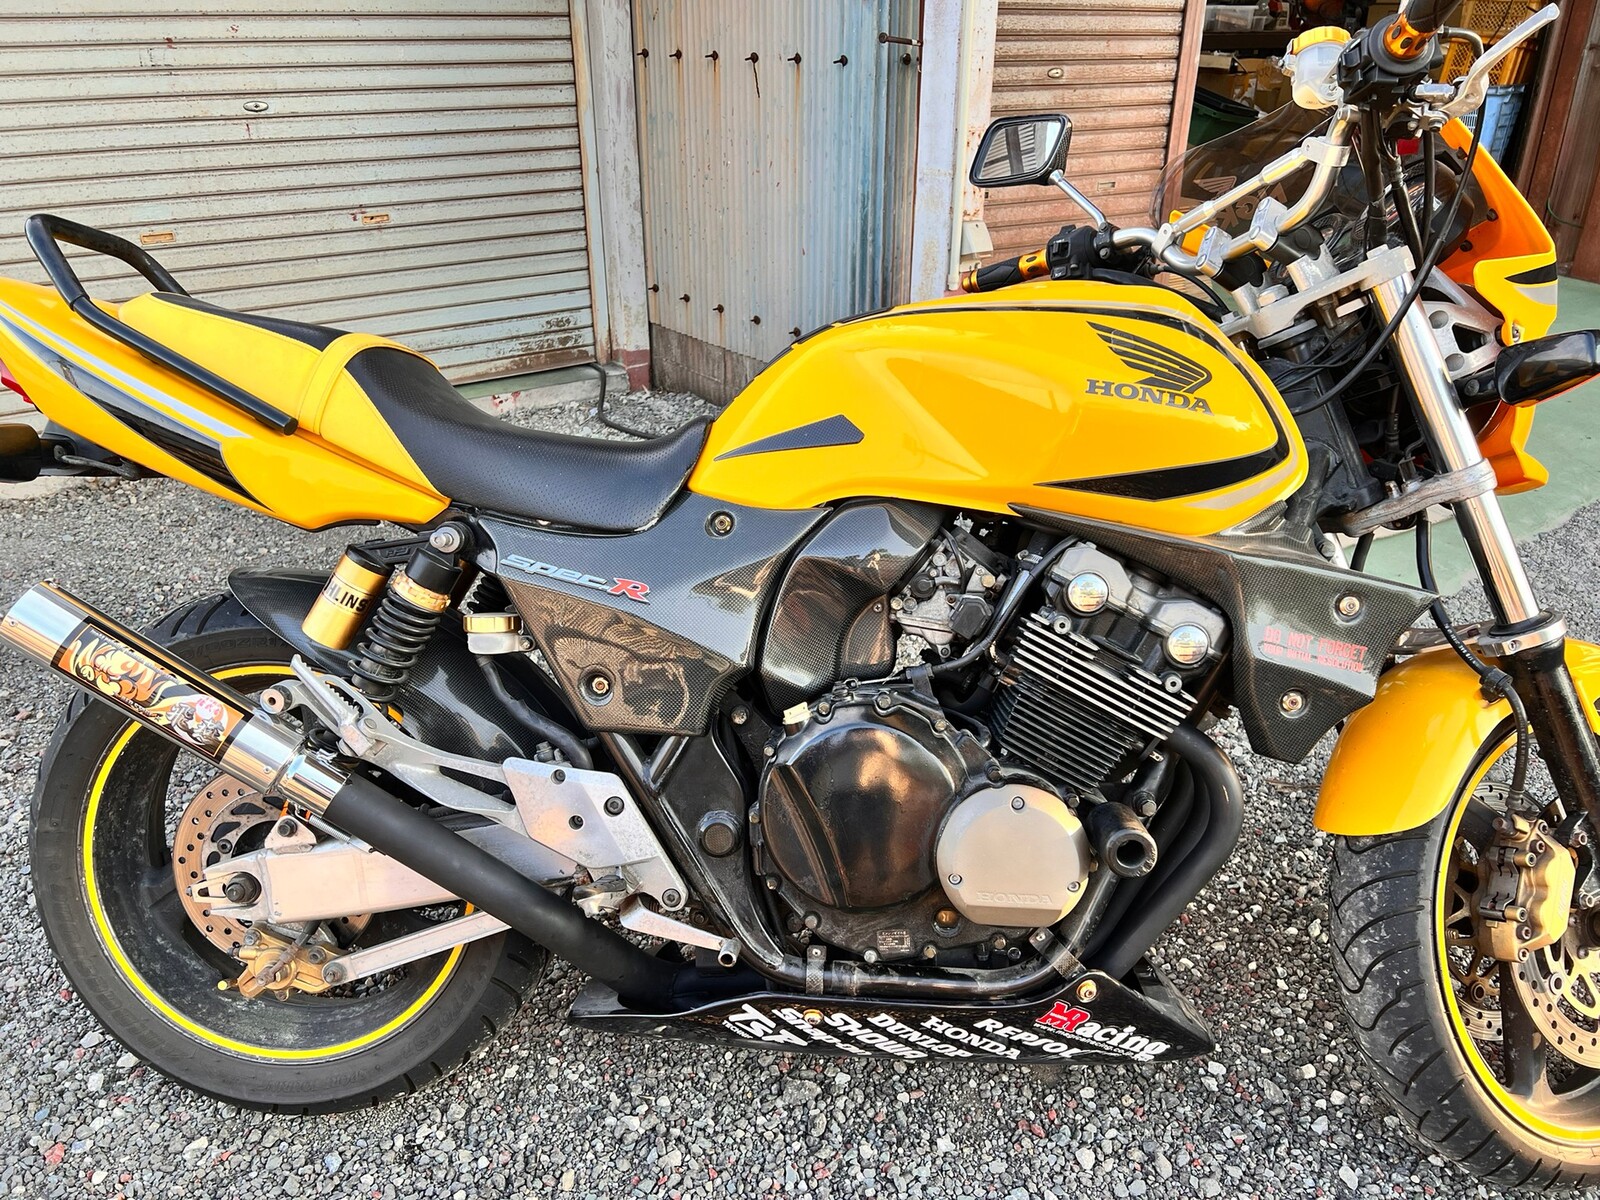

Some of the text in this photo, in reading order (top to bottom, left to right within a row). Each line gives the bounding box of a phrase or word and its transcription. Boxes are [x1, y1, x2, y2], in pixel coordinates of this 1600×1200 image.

[1085, 379, 1215, 416] HONDA
[323, 573, 371, 613] HLINS
[607, 577, 651, 605] R
[1264, 625, 1368, 661] DO NOT FORGET
[1316, 654, 1364, 673] RESOLUTION
[976, 891, 1053, 905] HONDA
[824, 1012, 928, 1059] SHOWA
[866, 1012, 973, 1058] DUNLOP
[920, 1015, 1021, 1060] HONDA
[973, 1018, 1083, 1058] REPSOL
